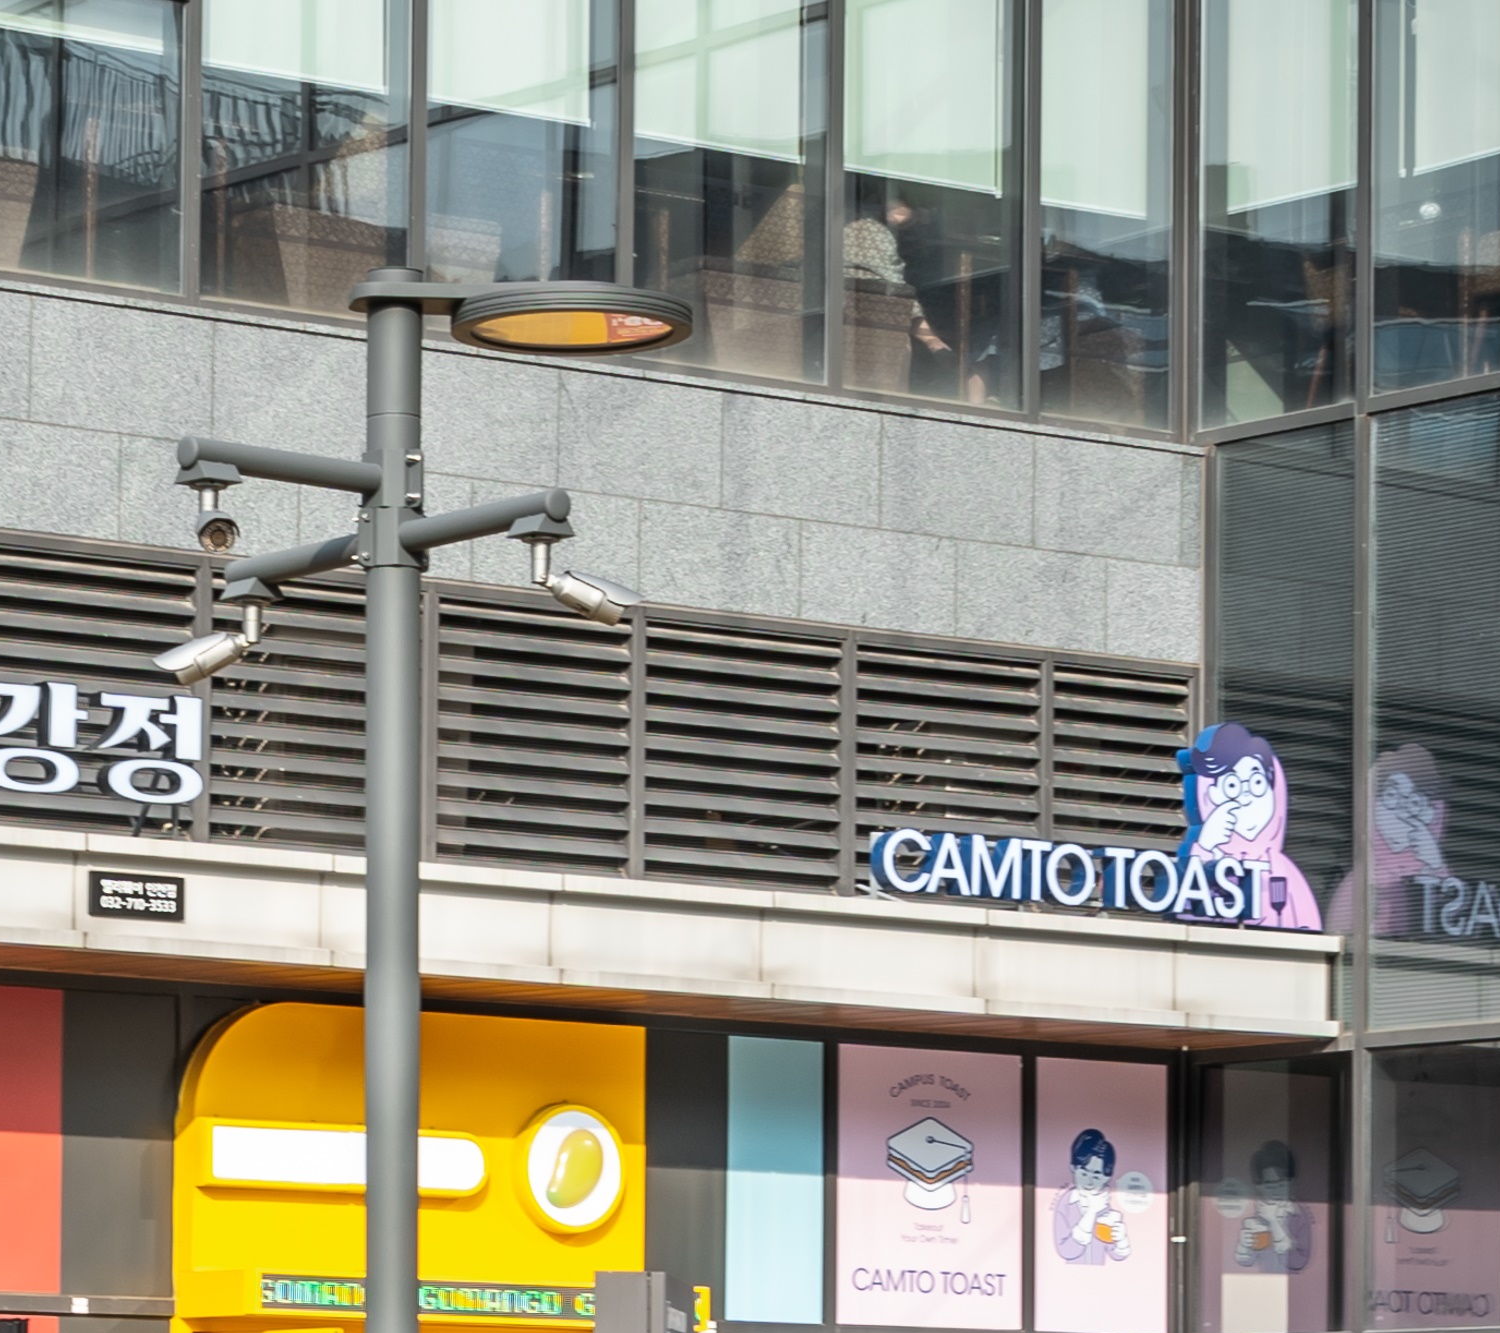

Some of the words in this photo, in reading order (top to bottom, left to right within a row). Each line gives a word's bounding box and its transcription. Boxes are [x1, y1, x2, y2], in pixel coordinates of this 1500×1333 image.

[872, 827, 1097, 908] CAMTO
[1101, 845, 1271, 921] TOAST
[851, 1267, 936, 1294] CAMTO
[939, 1271, 1007, 1297] TOAST
